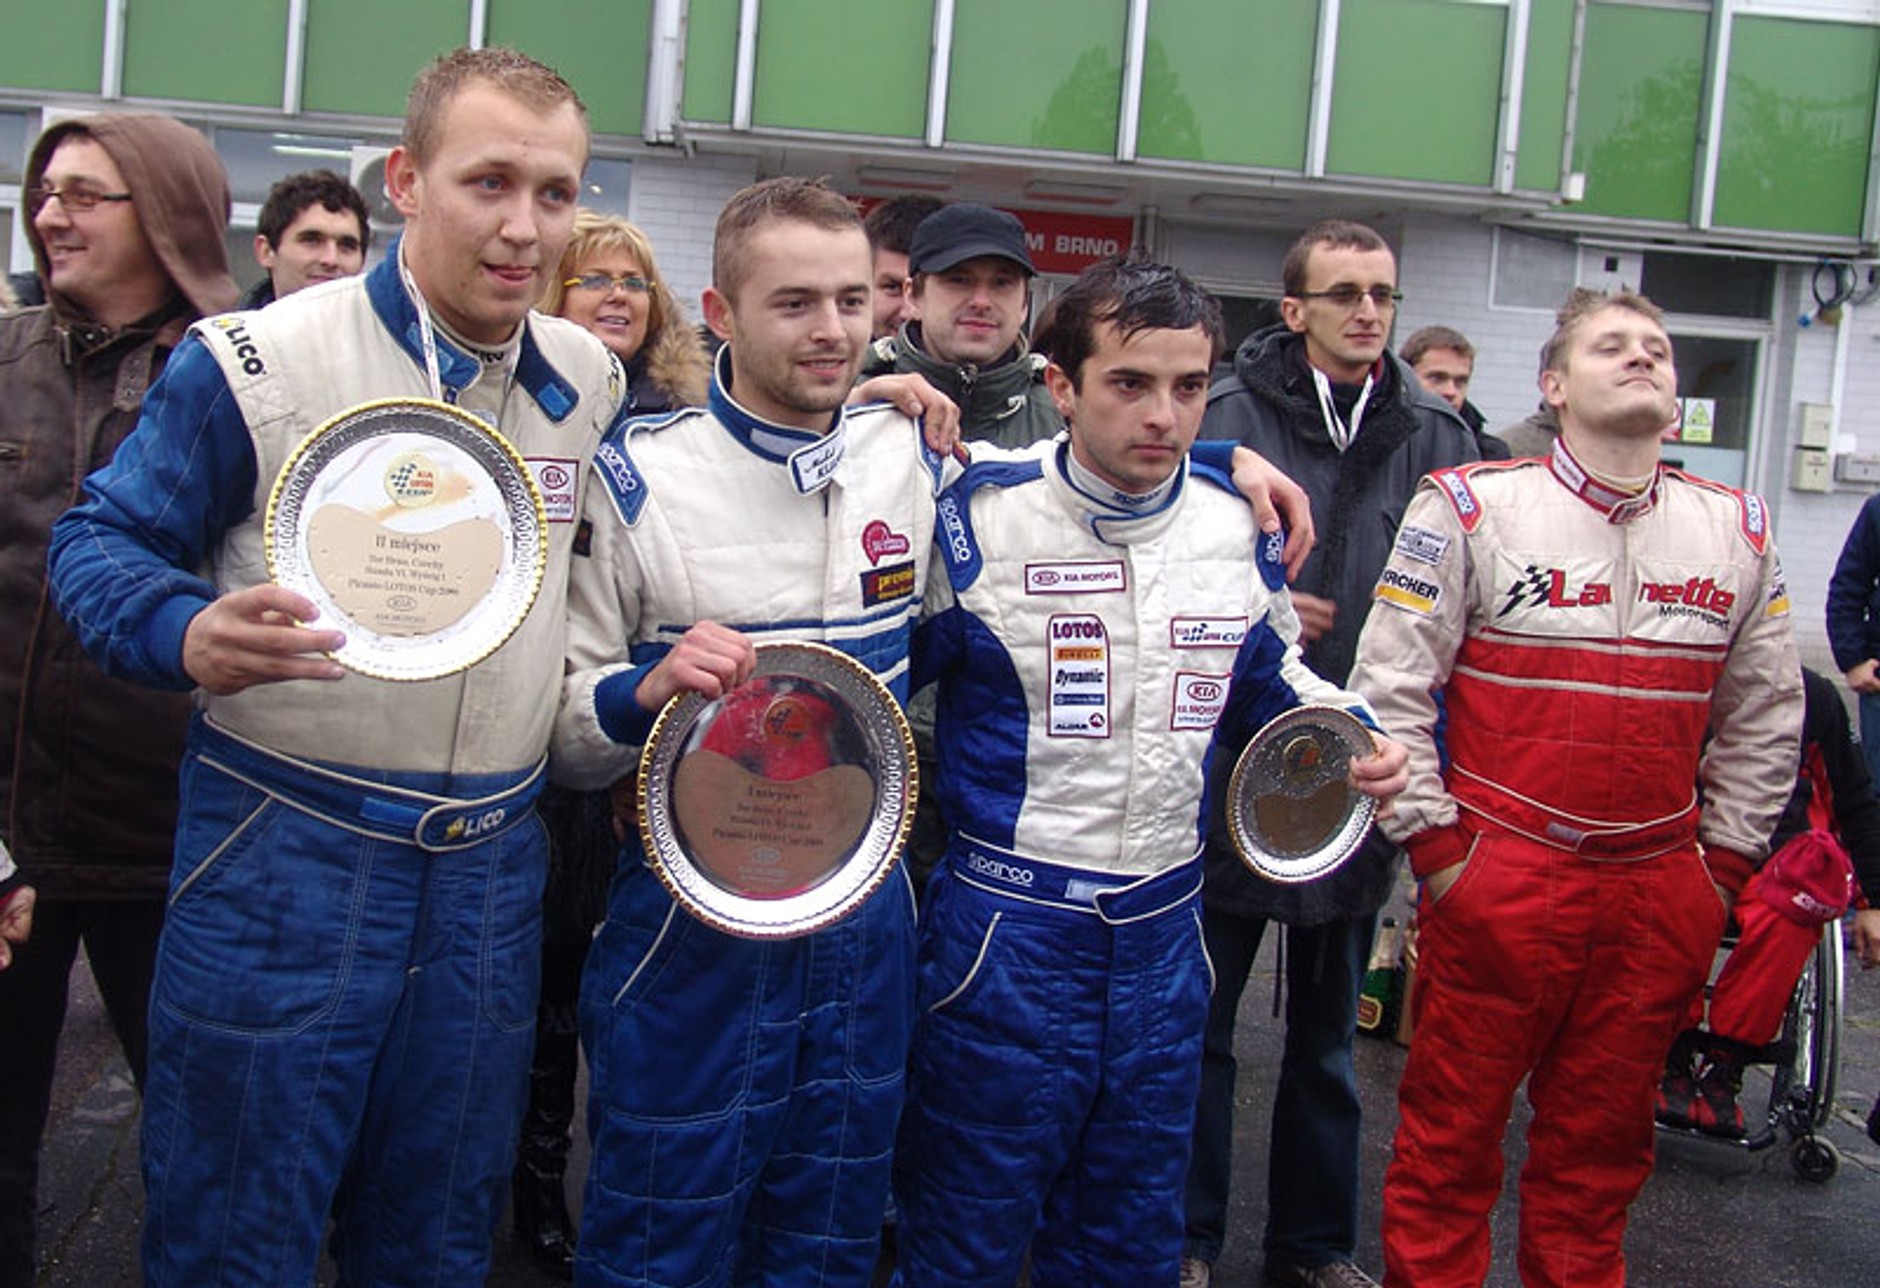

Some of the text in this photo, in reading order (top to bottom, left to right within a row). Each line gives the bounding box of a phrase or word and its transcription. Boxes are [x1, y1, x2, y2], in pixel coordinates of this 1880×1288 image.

[1055, 235, 1118, 257] BRNO
[225, 326, 264, 376] LICO
[939, 498, 971, 563] sparco
[390, 537, 442, 553] miejsce
[1064, 574, 1079, 583] KIA
[1081, 571, 1119, 583] MOTORS
[1658, 604, 1731, 631] Motorsport
[1053, 622, 1103, 639] LOTOS
[1055, 667, 1105, 687] Dynamic
[463, 808, 506, 838] LICO
[968, 851, 1035, 887] sparco
